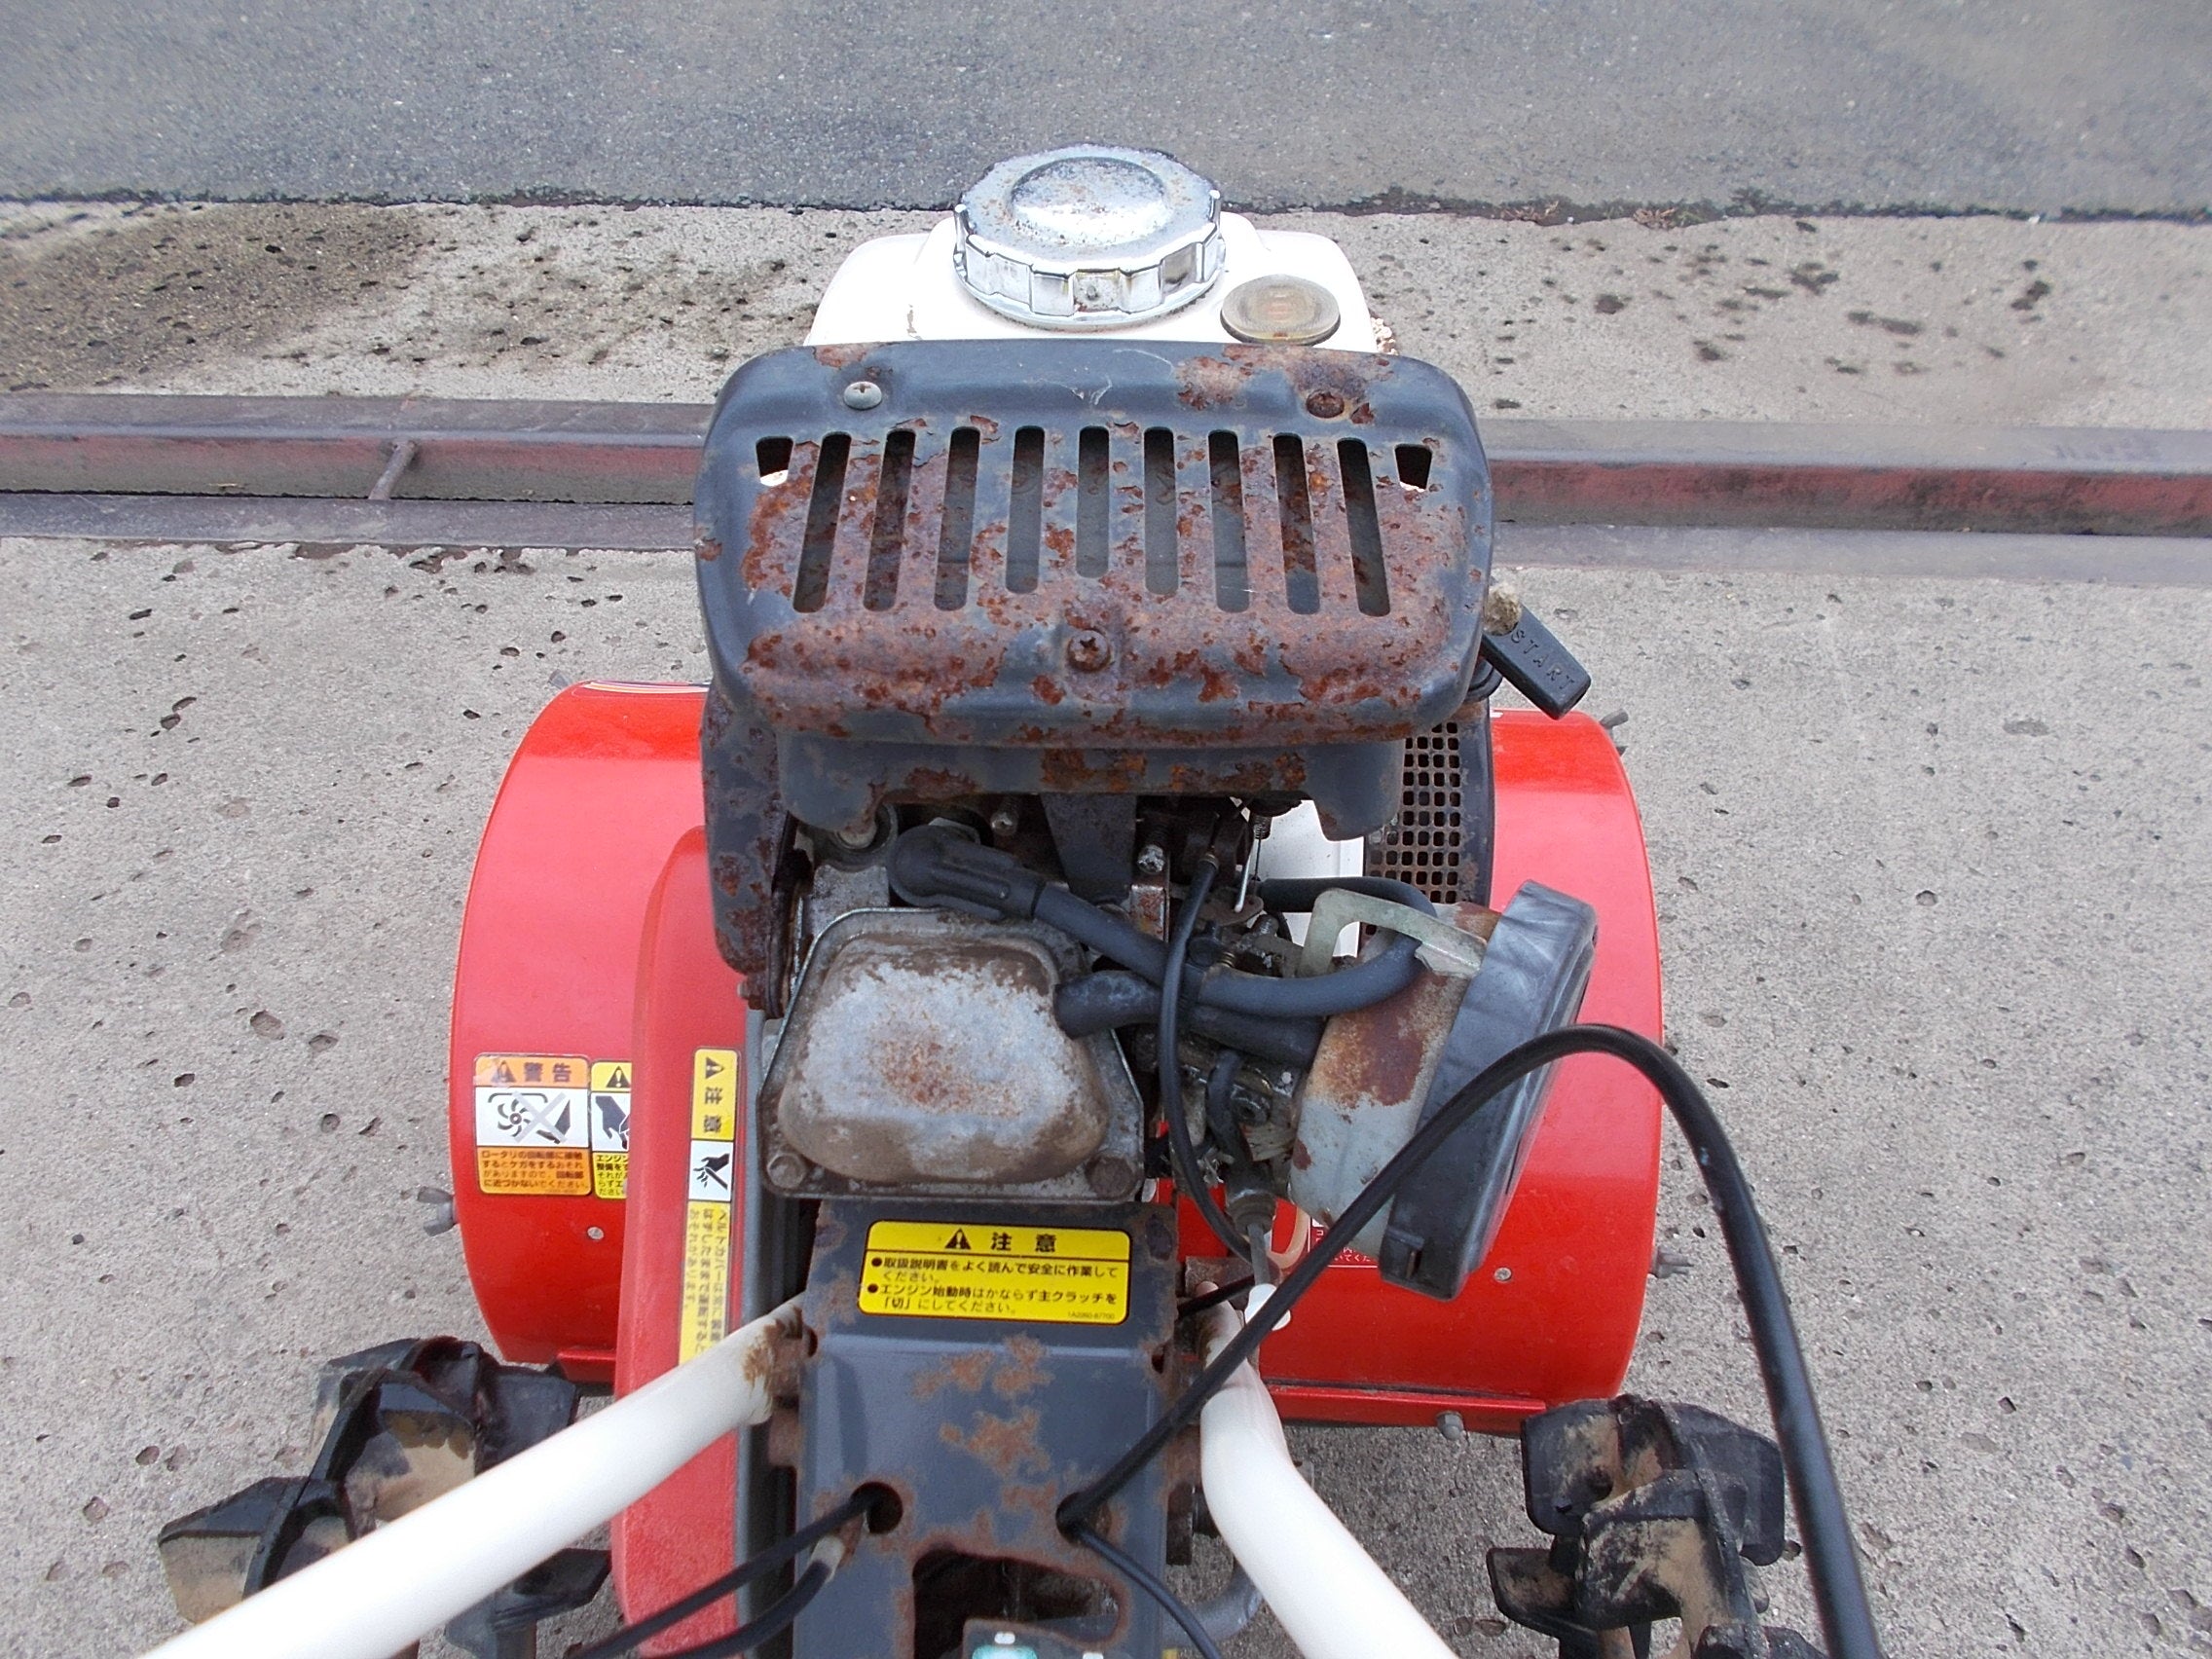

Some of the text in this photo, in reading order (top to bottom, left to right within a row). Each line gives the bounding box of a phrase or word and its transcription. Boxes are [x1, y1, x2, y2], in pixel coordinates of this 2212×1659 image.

[1510, 629, 1575, 690] START
[523, 1062, 572, 1083] 警告
[703, 1087, 723, 1133] 注意
[990, 1232, 1057, 1253] 注意
